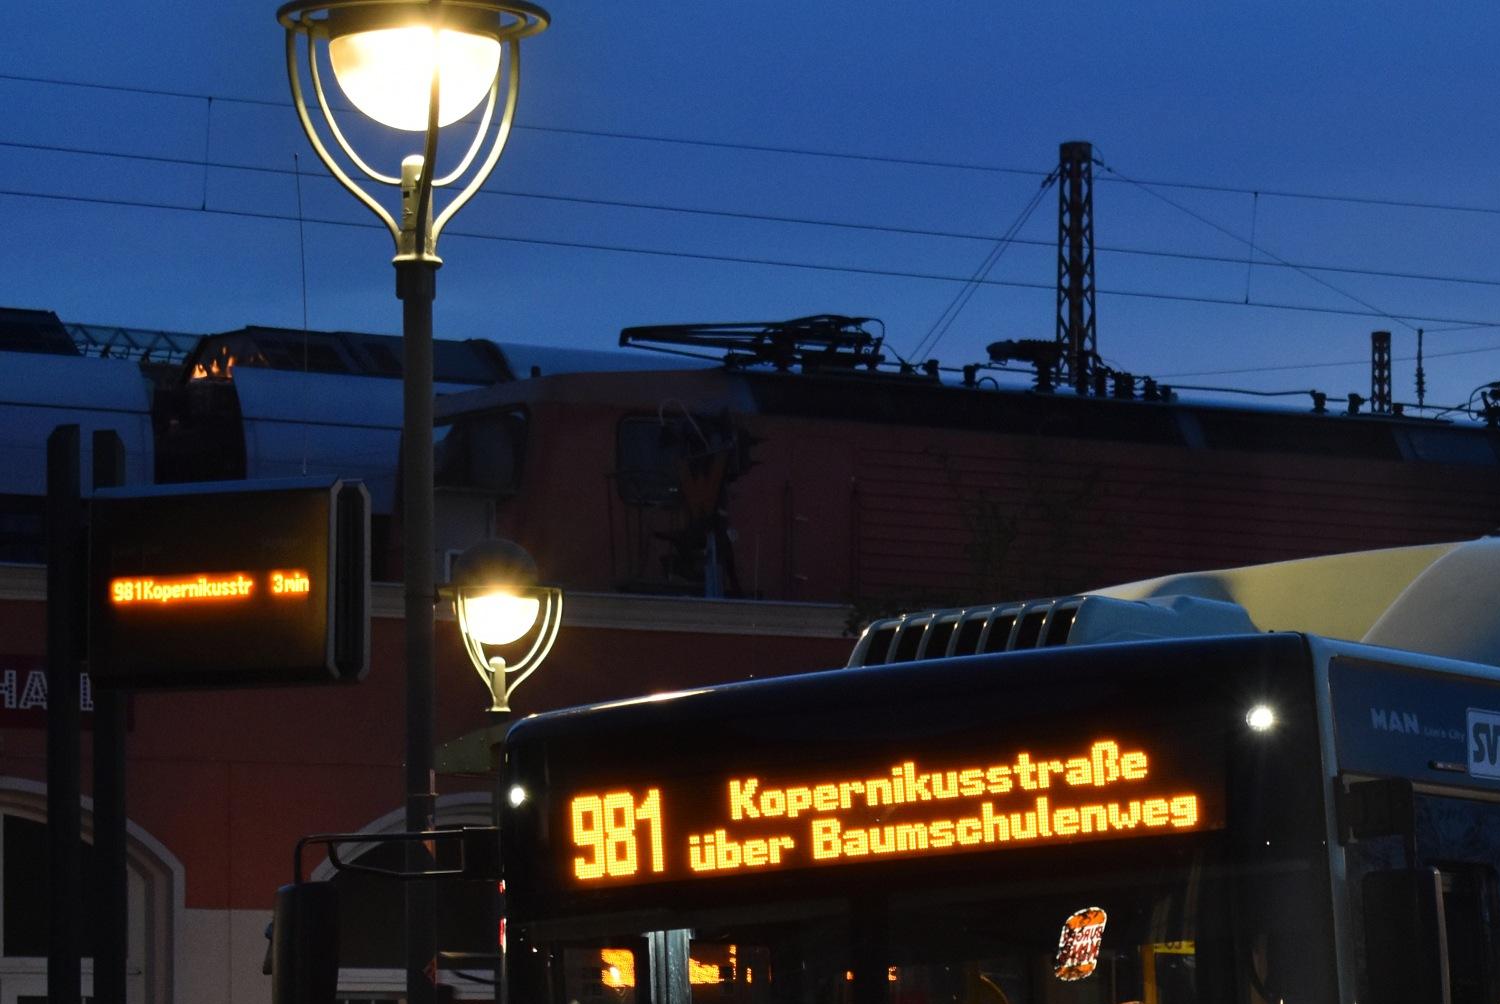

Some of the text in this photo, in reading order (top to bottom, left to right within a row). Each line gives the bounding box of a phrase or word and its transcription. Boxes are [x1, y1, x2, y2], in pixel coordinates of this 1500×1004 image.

[1370, 707, 1420, 735] MAN
[728, 741, 1148, 821] Kopernikusstraße
[571, 788, 665, 879] 981
[688, 796, 1198, 872] über Baumschulenweg
